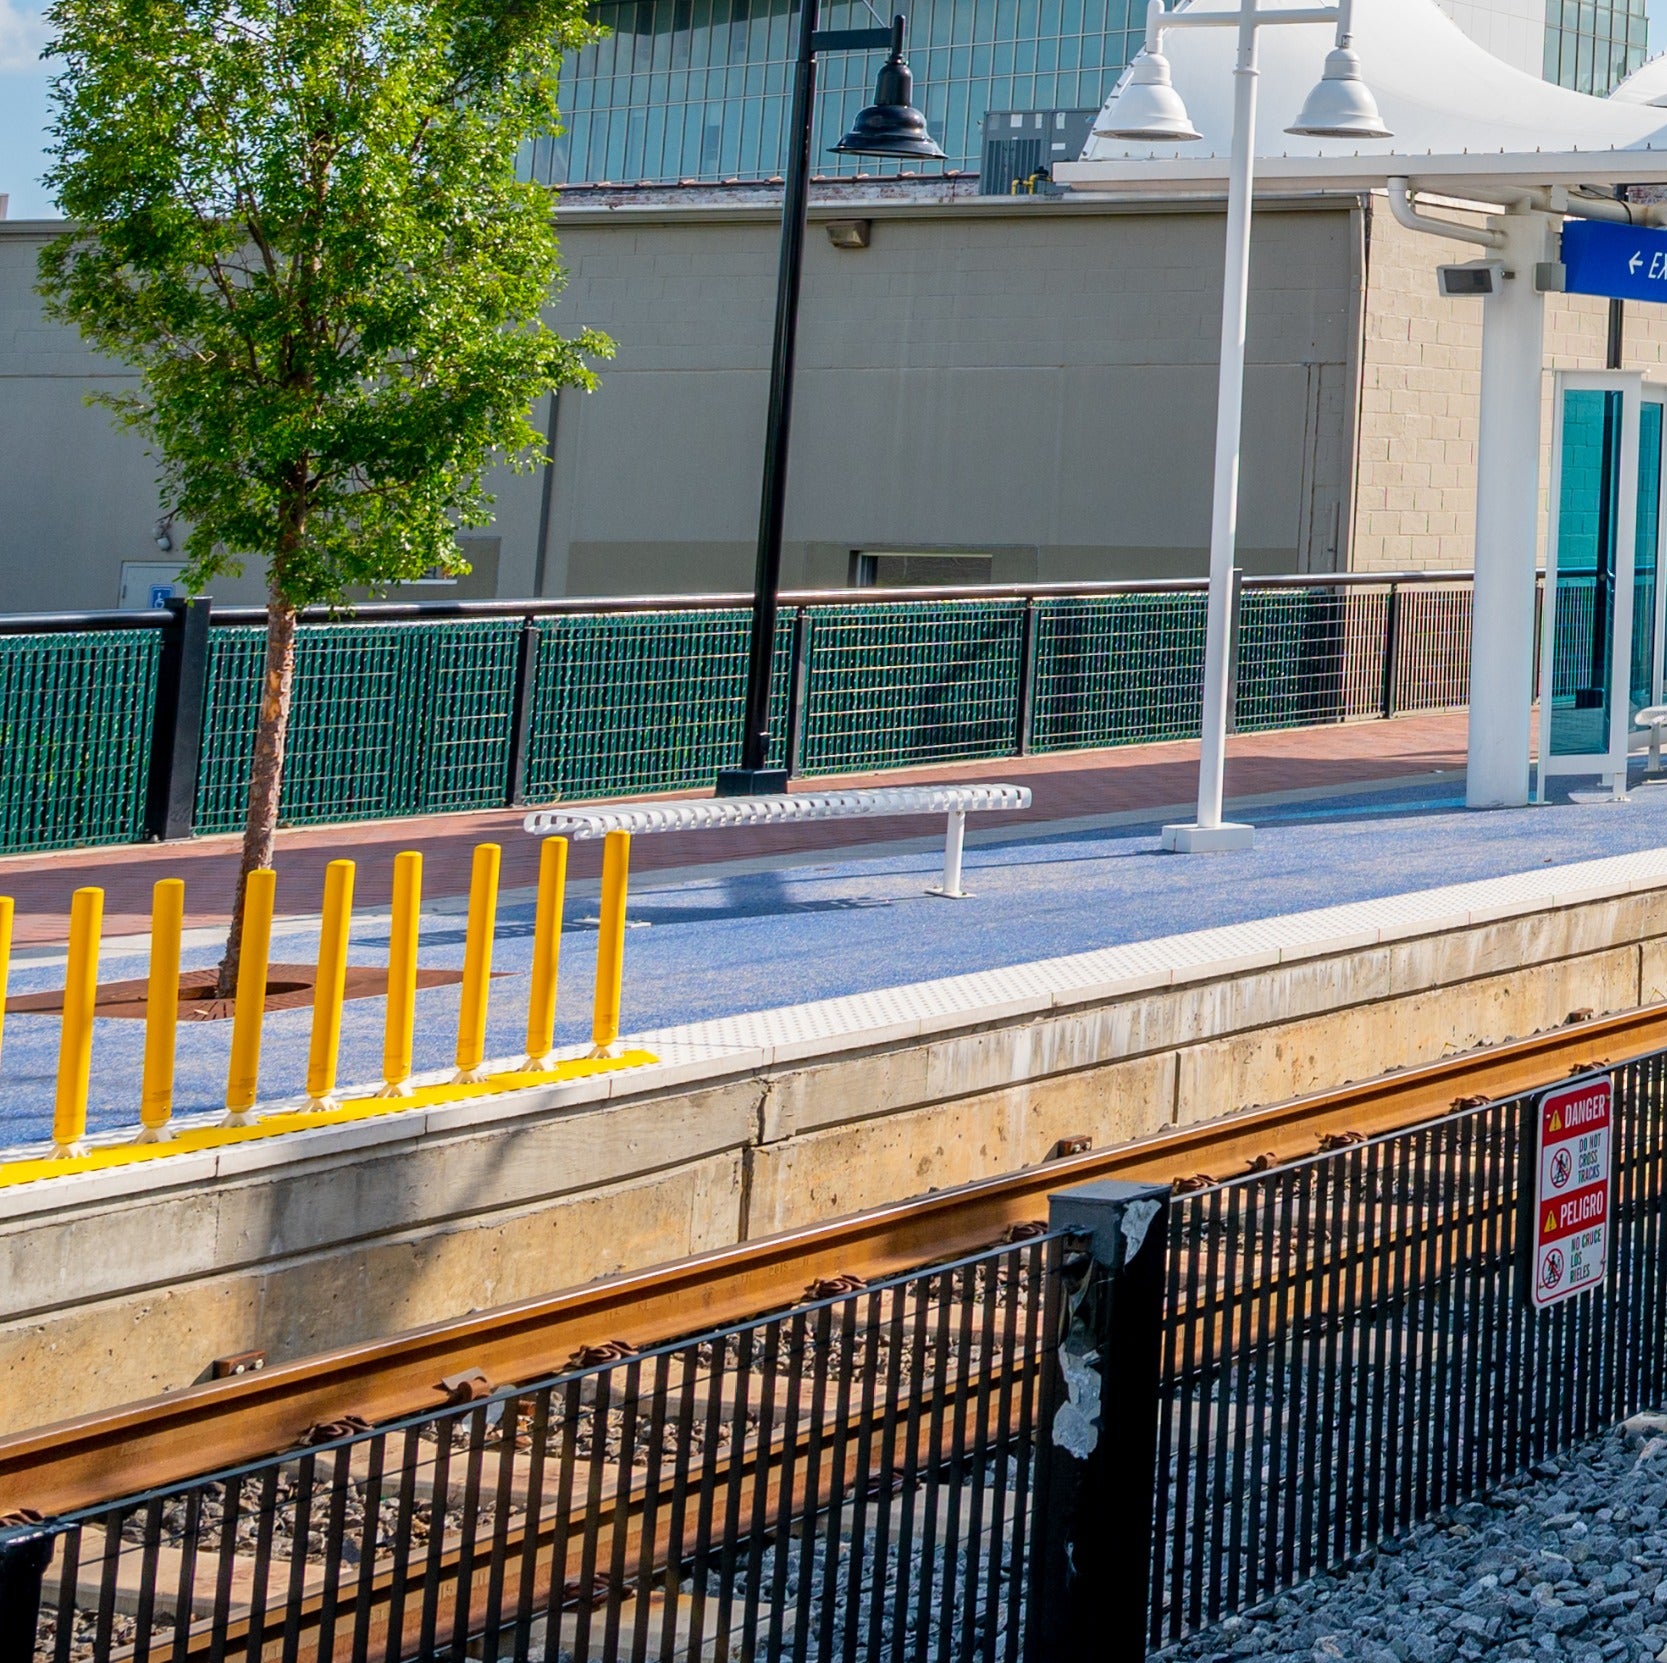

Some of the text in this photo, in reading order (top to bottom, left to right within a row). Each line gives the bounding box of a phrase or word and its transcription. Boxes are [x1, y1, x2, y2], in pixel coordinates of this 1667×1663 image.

[1564, 1093, 1605, 1129] DANGER
[1578, 1133, 1601, 1153] DO NOT
[1578, 1150, 1598, 1168] CROSS
[1578, 1165, 1600, 1185] TRACKS
[1560, 1189, 1604, 1228] PELIGRO
[1571, 1228, 1602, 1253] NO CRUCE
[1570, 1251, 1583, 1268] LOS
[1570, 1263, 1590, 1284] RIELES
